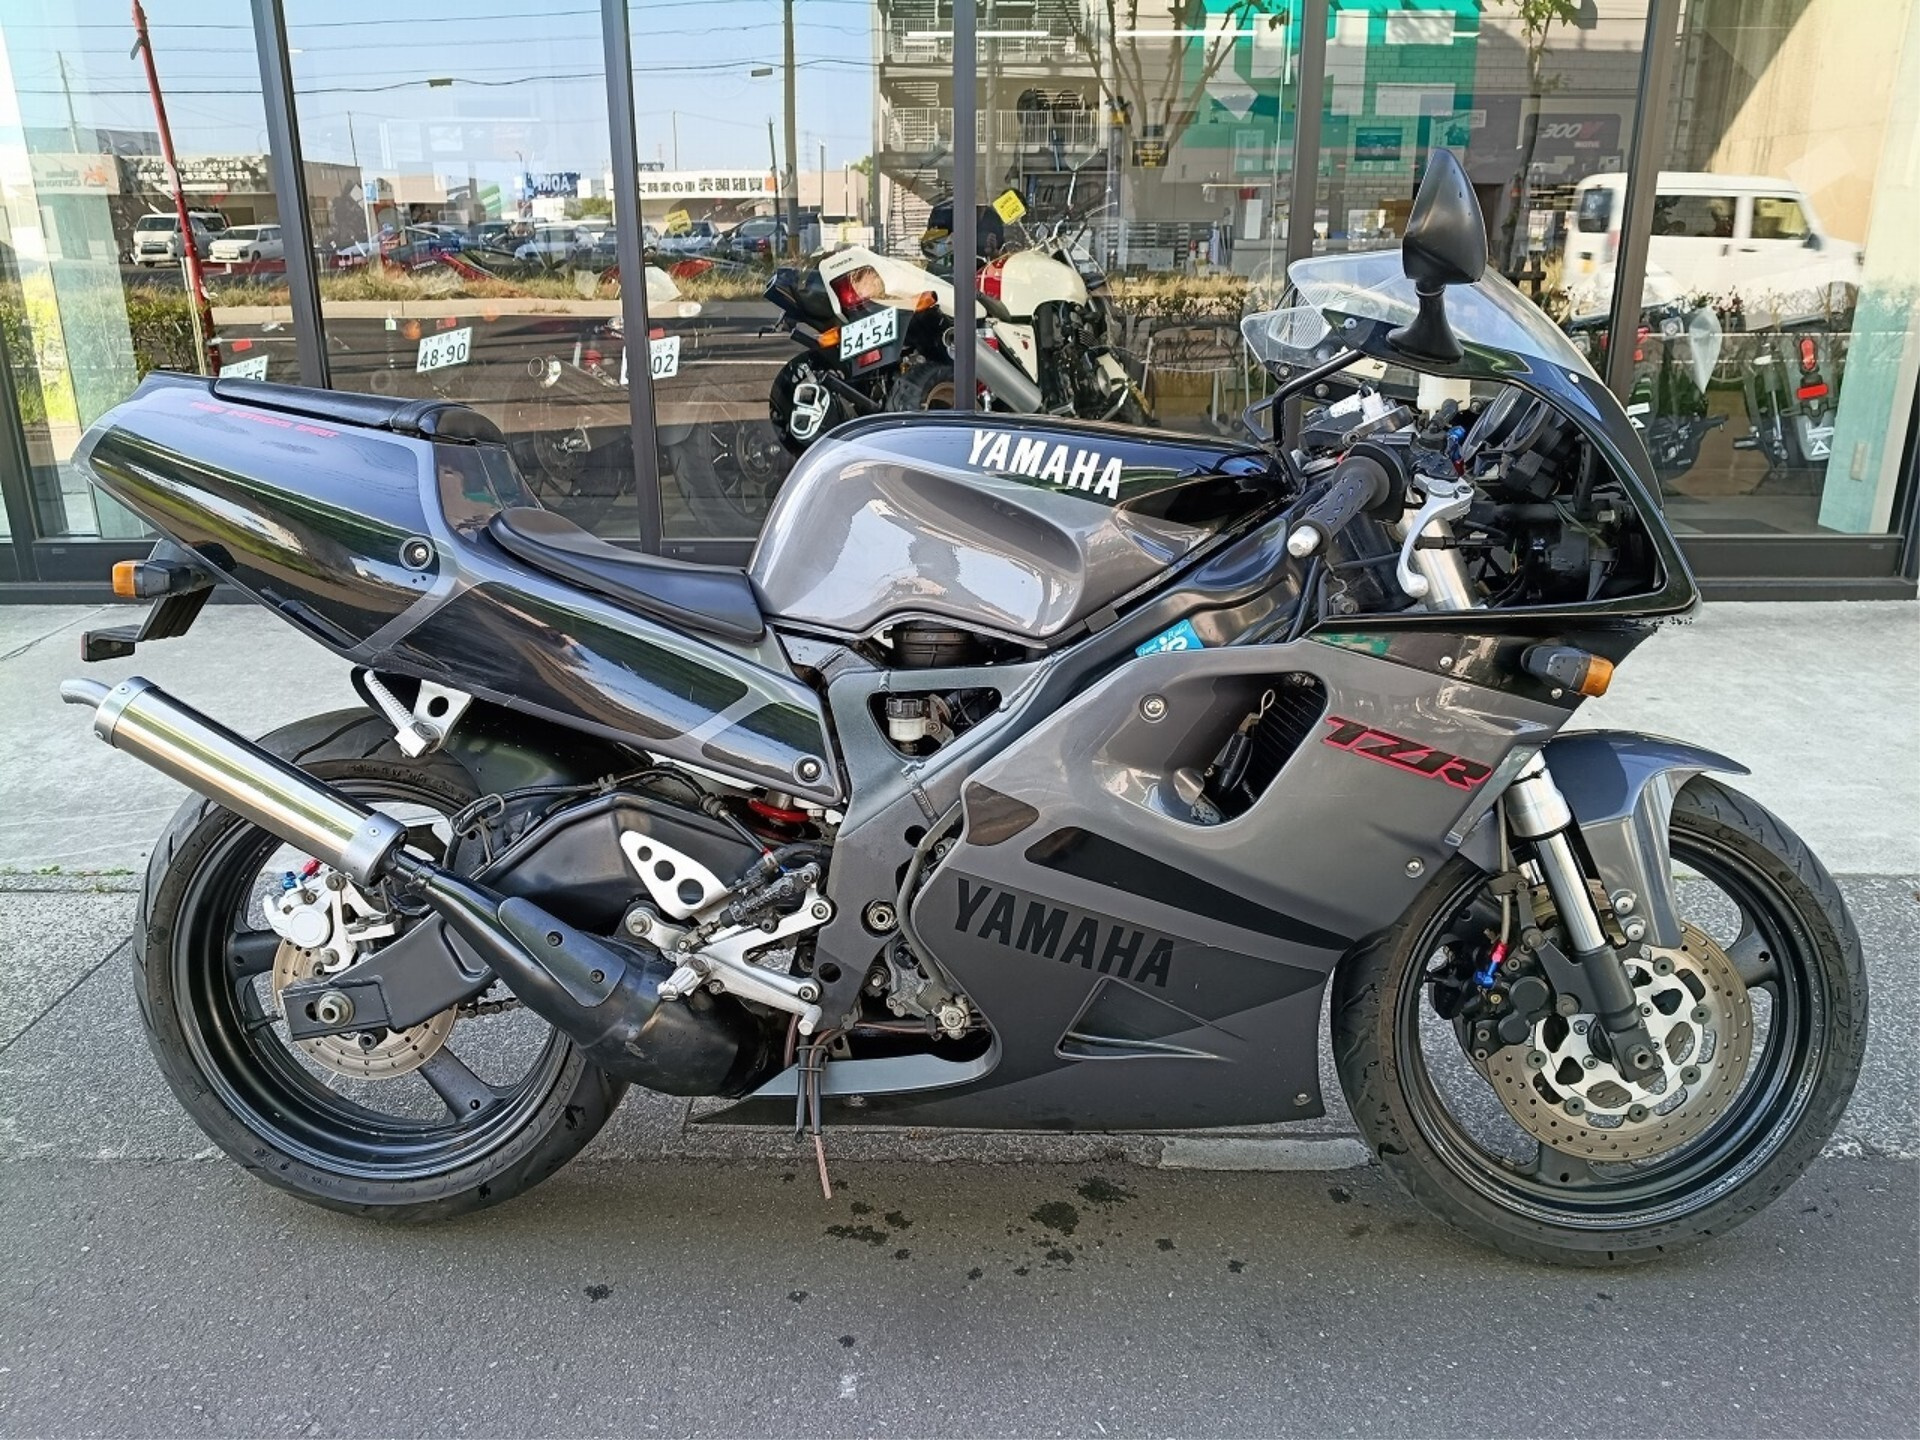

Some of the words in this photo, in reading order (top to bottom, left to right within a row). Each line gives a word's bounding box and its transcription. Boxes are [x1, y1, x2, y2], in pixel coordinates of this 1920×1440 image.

[420, 342, 466, 368] 48-90
[843, 320, 894, 356] 54-54
[968, 429, 1123, 500] YAMAHA
[1322, 715, 1493, 792] TZR
[955, 878, 1174, 988] YAMAHA
